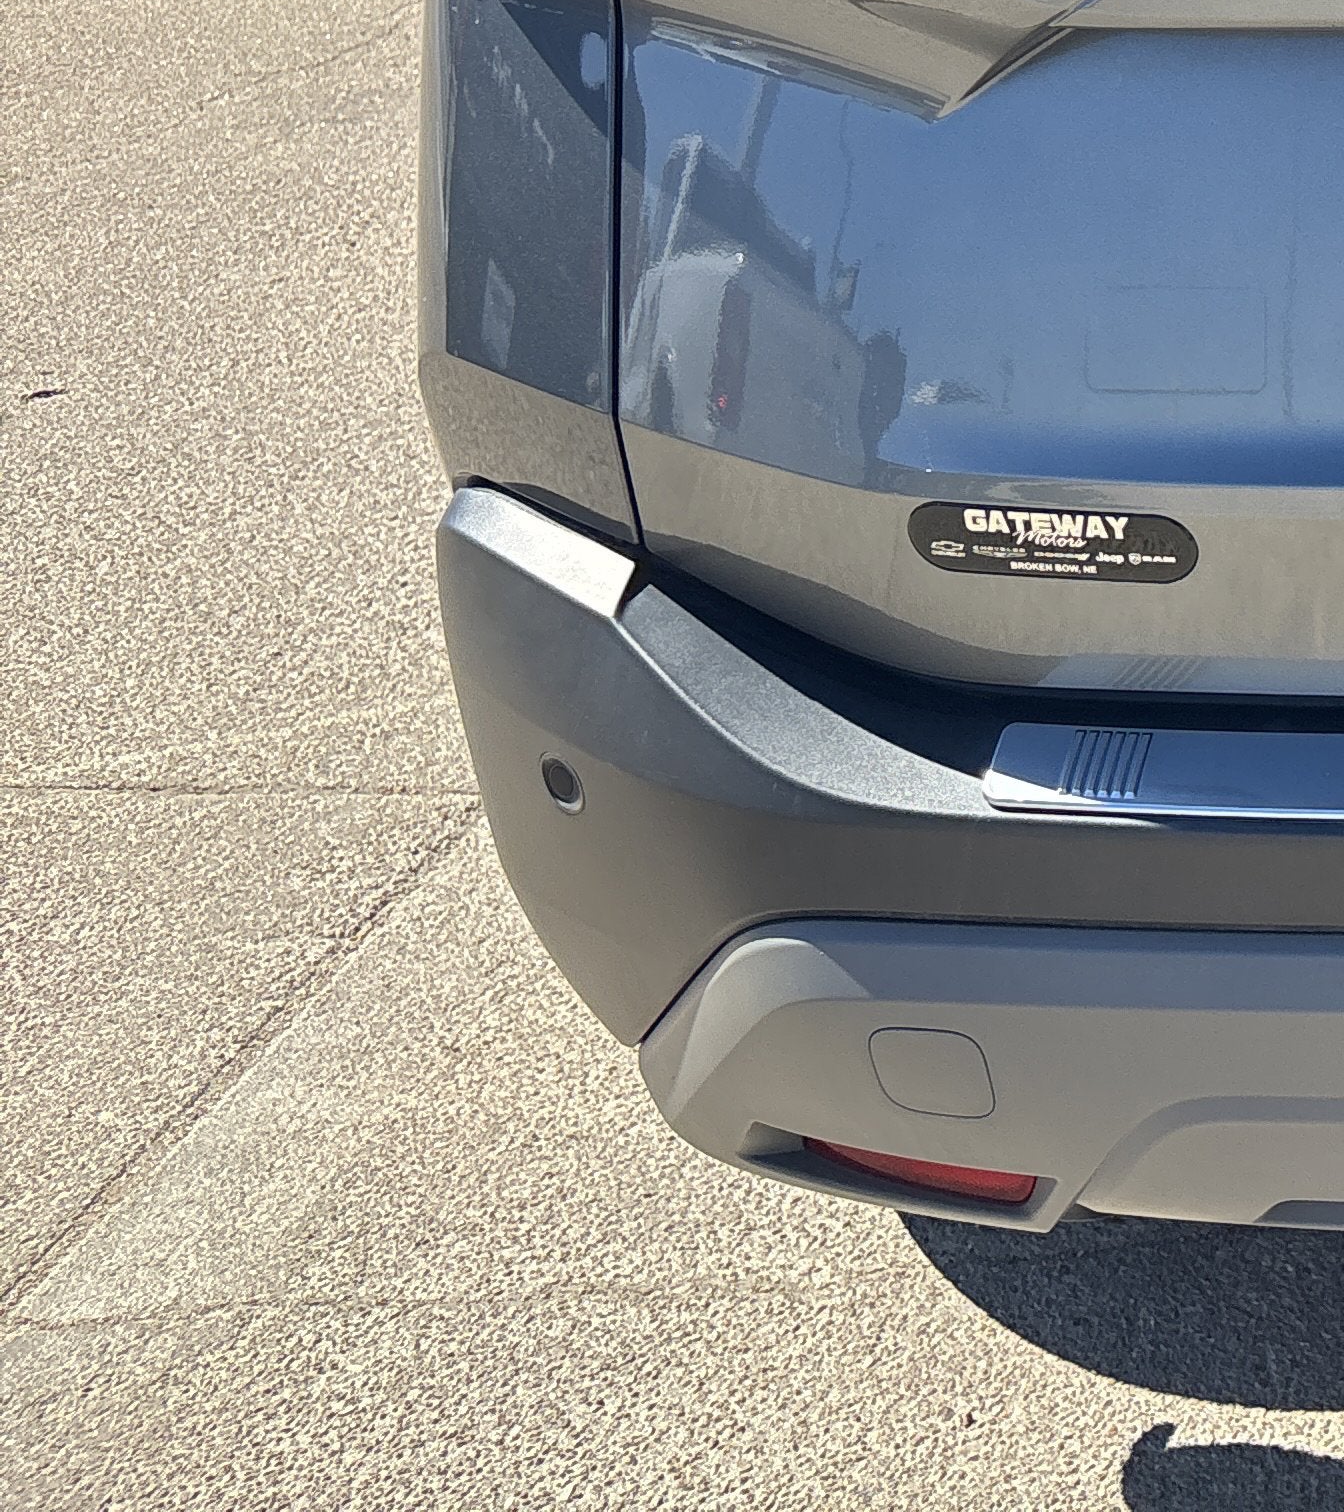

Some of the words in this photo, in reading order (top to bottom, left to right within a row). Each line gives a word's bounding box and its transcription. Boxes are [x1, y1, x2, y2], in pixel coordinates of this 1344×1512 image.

[963, 508, 1128, 540] GATEWAY
[1012, 528, 1087, 548] Motors
[1095, 552, 1124, 565] Jeep
[1010, 561, 1053, 571] BROKEN
[1083, 565, 1098, 574] NE
